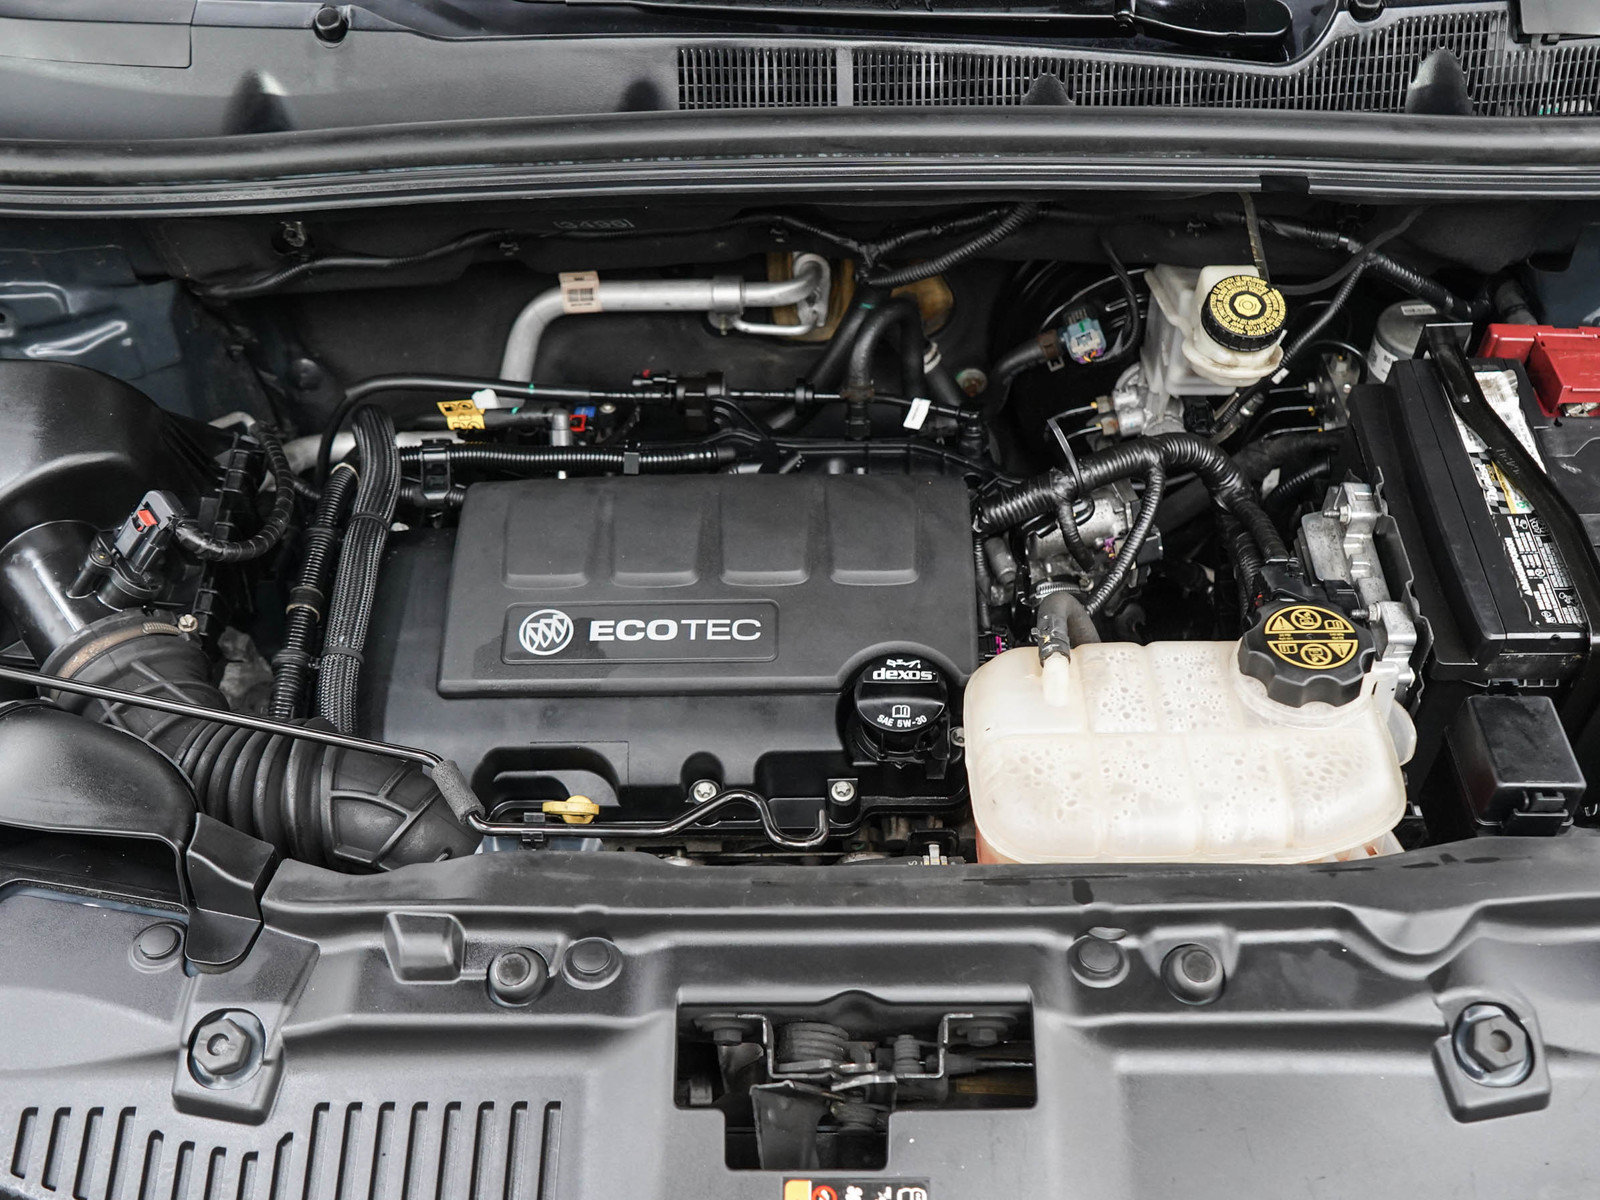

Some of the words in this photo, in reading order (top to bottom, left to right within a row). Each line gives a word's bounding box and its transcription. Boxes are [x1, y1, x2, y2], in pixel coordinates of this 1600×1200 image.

[589, 618, 762, 642] ECOTEC
[872, 667, 933, 680] dexos
[876, 714, 895, 727] SAE
[896, 715, 928, 728] 5W-30
